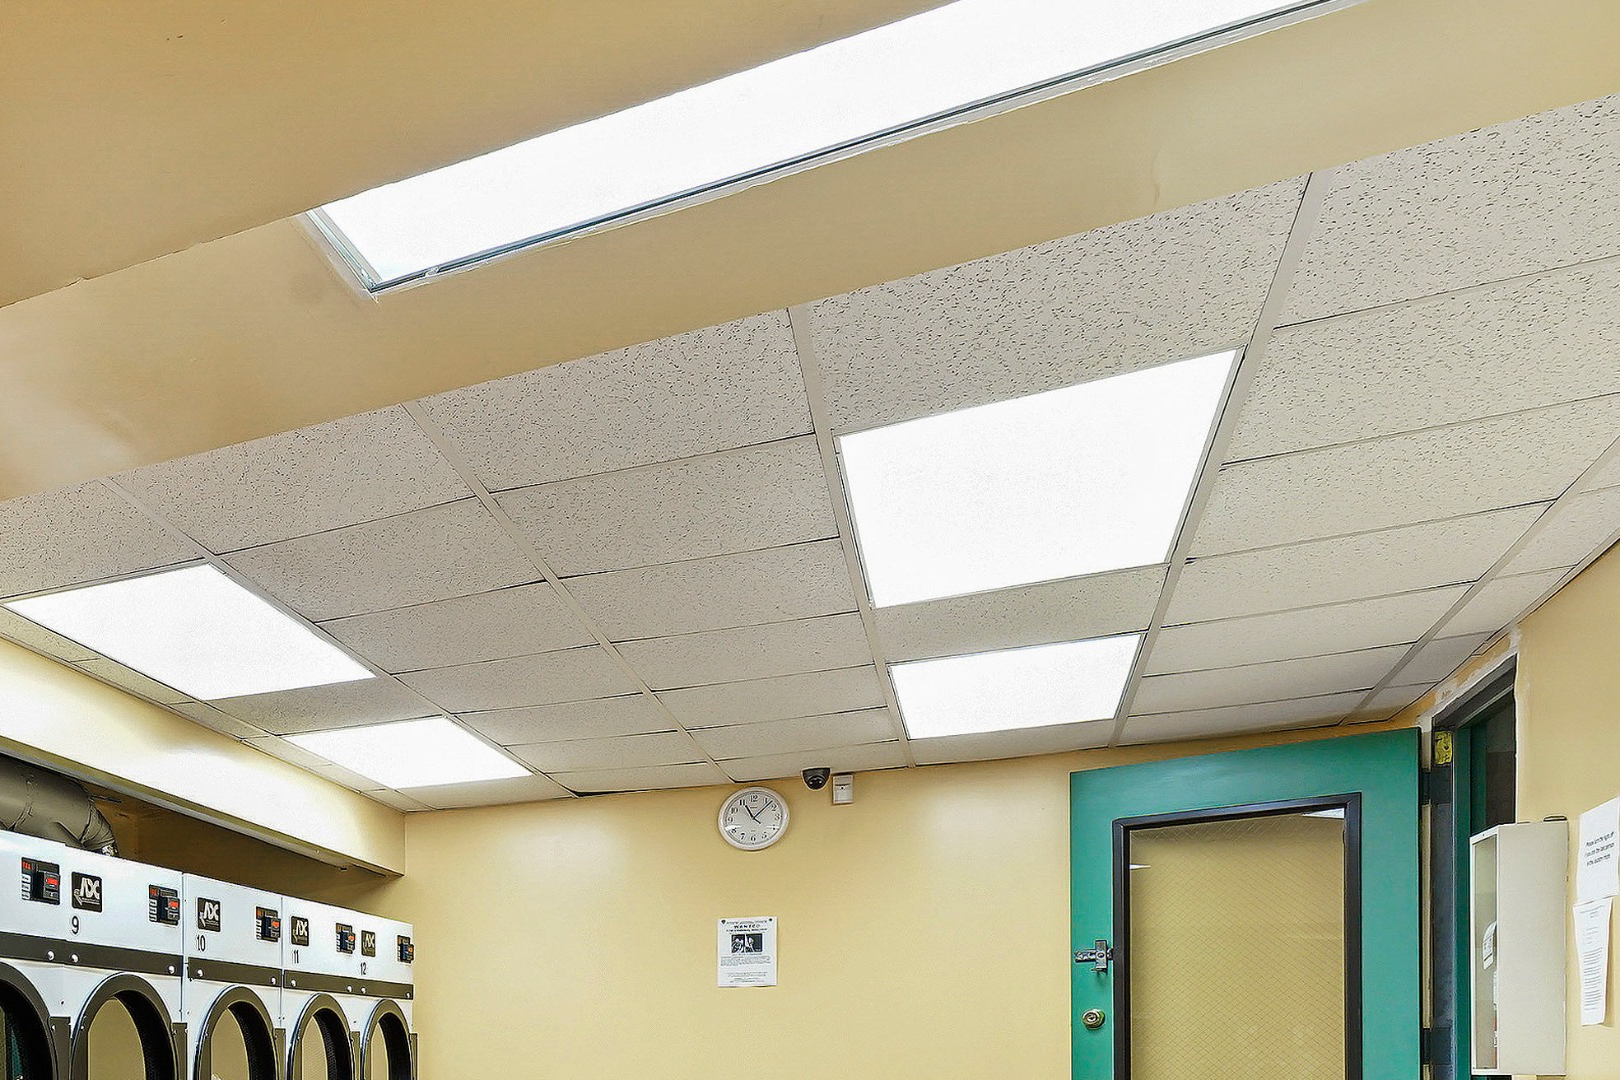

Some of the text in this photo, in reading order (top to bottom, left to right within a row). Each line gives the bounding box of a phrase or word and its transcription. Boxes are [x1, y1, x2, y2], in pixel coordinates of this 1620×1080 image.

[71, 915, 79, 935] 9
[196, 934, 206, 952] 10
[293, 950, 300, 964] 11
[360, 962, 367, 976] 12
